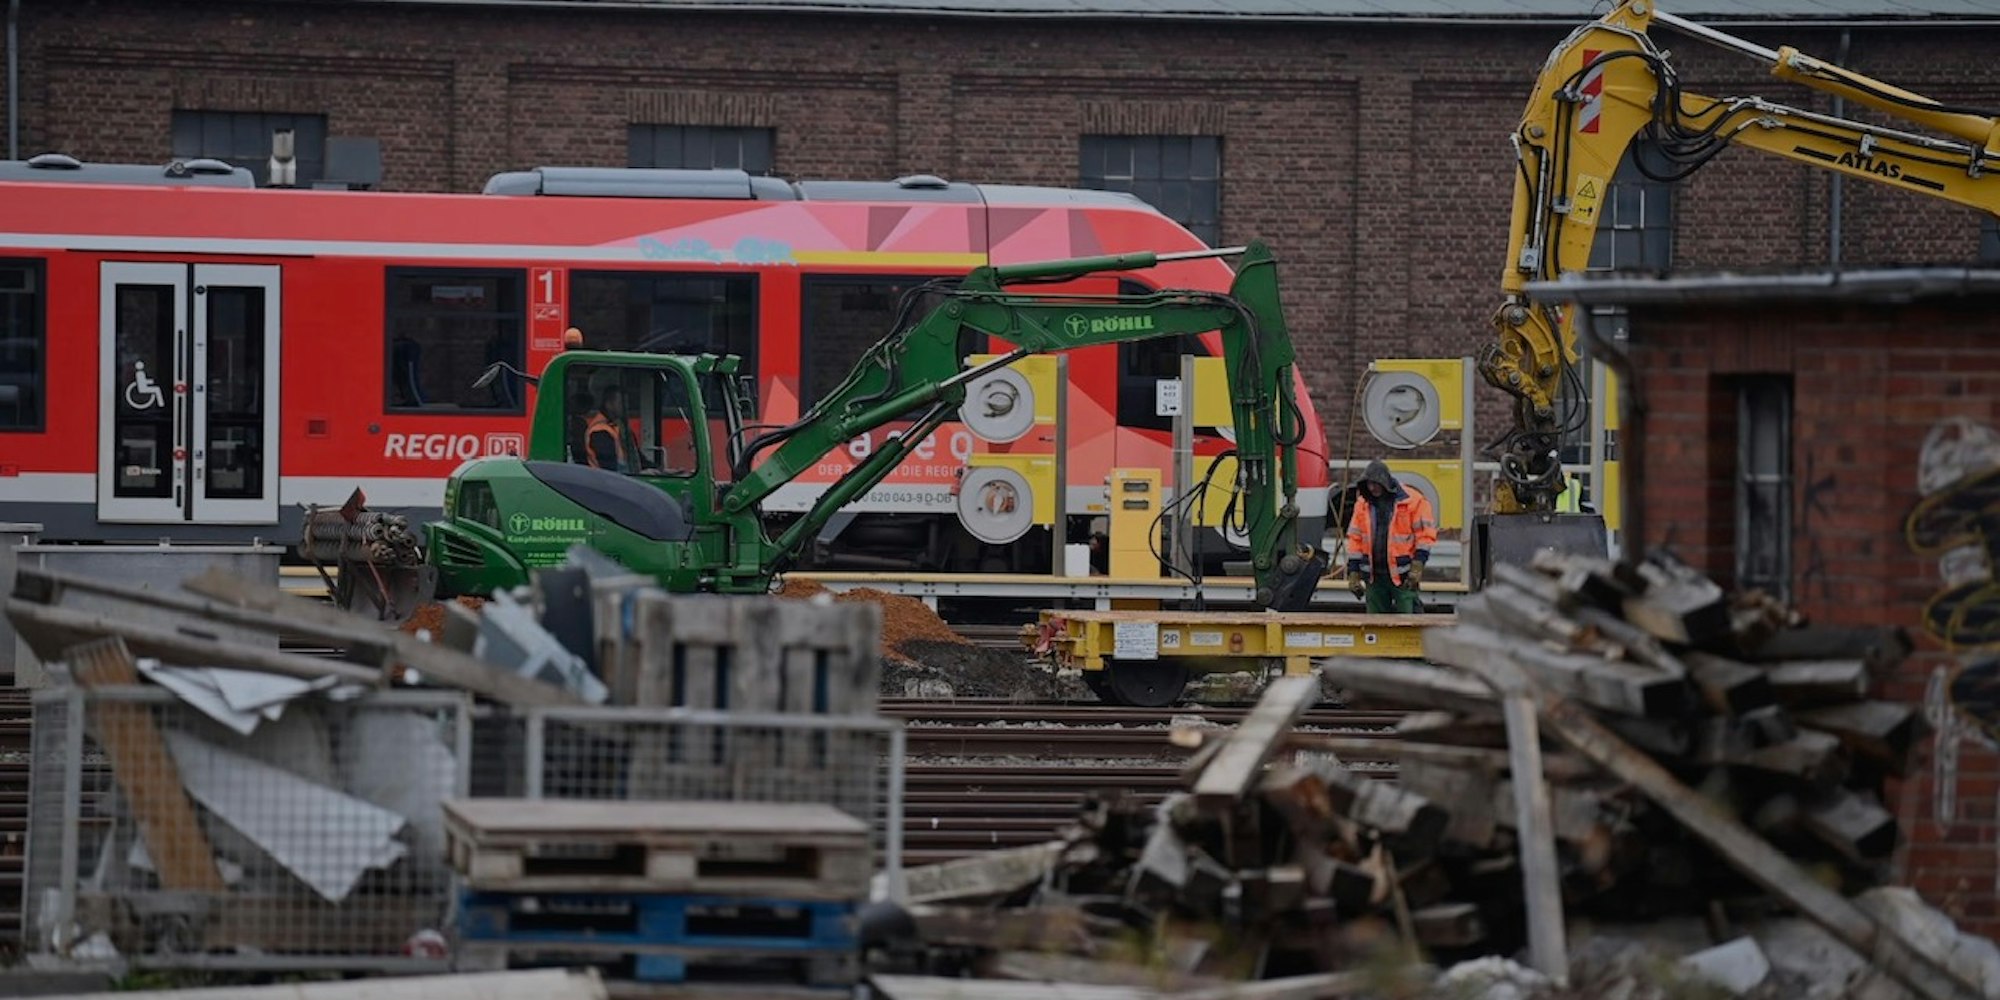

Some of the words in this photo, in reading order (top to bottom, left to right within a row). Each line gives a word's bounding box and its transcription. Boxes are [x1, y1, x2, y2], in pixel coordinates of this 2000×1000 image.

[1838, 152, 1901, 177] ATLAS
[538, 270, 552, 304] 1
[1091, 315, 1155, 333] RÖHLL
[384, 433, 480, 460] REGIO
[488, 437, 518, 457] DB
[818, 464, 843, 476] DER
[901, 464, 922, 477] DIE
[531, 516, 586, 531] RÖHLL
[1163, 633, 1179, 645] 2R
